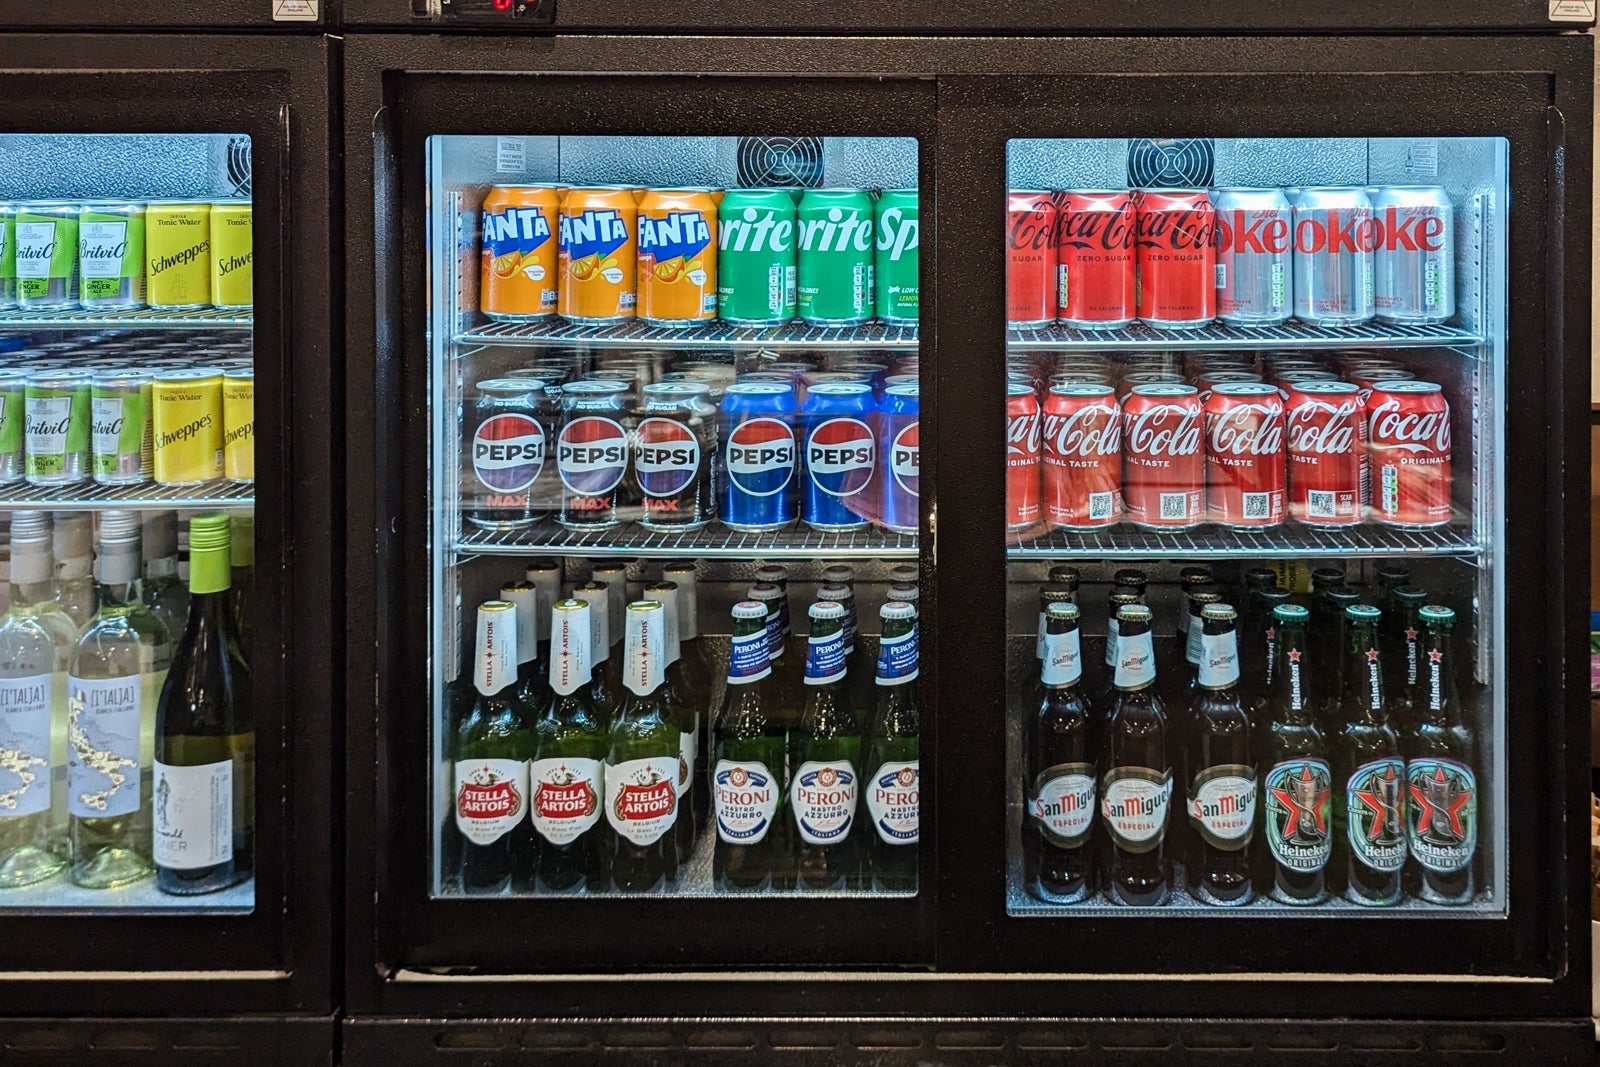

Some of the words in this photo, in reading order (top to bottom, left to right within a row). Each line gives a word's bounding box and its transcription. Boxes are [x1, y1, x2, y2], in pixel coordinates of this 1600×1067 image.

[638, 212, 709, 248] FANTA
[719, 207, 792, 251] rite
[877, 208, 918, 260] Sp
[81, 239, 126, 259] BritviC
[151, 239, 210, 276] Schweppes
[26, 414, 70, 434] BritviC
[154, 413, 212, 451] Schweppes
[476, 443, 542, 461] PEPSI
[560, 445, 625, 463] PEPSI
[635, 448, 694, 465] PEPSI
[730, 447, 792, 464] PEPSI
[811, 447, 873, 465] PEPSI
[1069, 460, 1099, 468] TASTE
[1141, 459, 1170, 468] TASTE
[1223, 458, 1253, 467] TASTE
[1292, 456, 1318, 465] TASTE
[1401, 456, 1444, 465] ORIGINAL
[486, 495, 527, 507] MAX
[570, 497, 611, 510] MAX
[641, 497, 679, 511] MAX
[734, 641, 761, 654] PERONI
[815, 640, 841, 654] PERONI
[1408, 642, 1416, 684] Heineken
[1290, 664, 1301, 710] Heineken
[1370, 664, 1381, 710] Heineken
[1430, 664, 1440, 710] Heineken
[465, 789, 509, 801] STELLA
[542, 788, 586, 801] STELLA
[625, 788, 669, 802] STELLA
[715, 784, 770, 806] PERONI
[798, 786, 855, 806] PERONI
[875, 788, 919, 805] PERO
[1103, 783, 1169, 819] SanMiguel
[464, 799, 509, 811] ARTOIS
[540, 799, 586, 811] ARTOIS
[624, 799, 669, 814] ARTOIS
[720, 810, 763, 819] AZZURRO
[804, 809, 849, 819] AZZURRO
[1053, 817, 1088, 827] ESPECIAL
[1117, 822, 1155, 830] ESPECIAL
[1211, 820, 1247, 829] ESPECIAL
[1279, 844, 1329, 857] Heineken
[1413, 840, 1469, 857] Heineken
[1287, 858, 1327, 867] ORIGINAL
[1420, 854, 1462, 867] ORIGINAL
